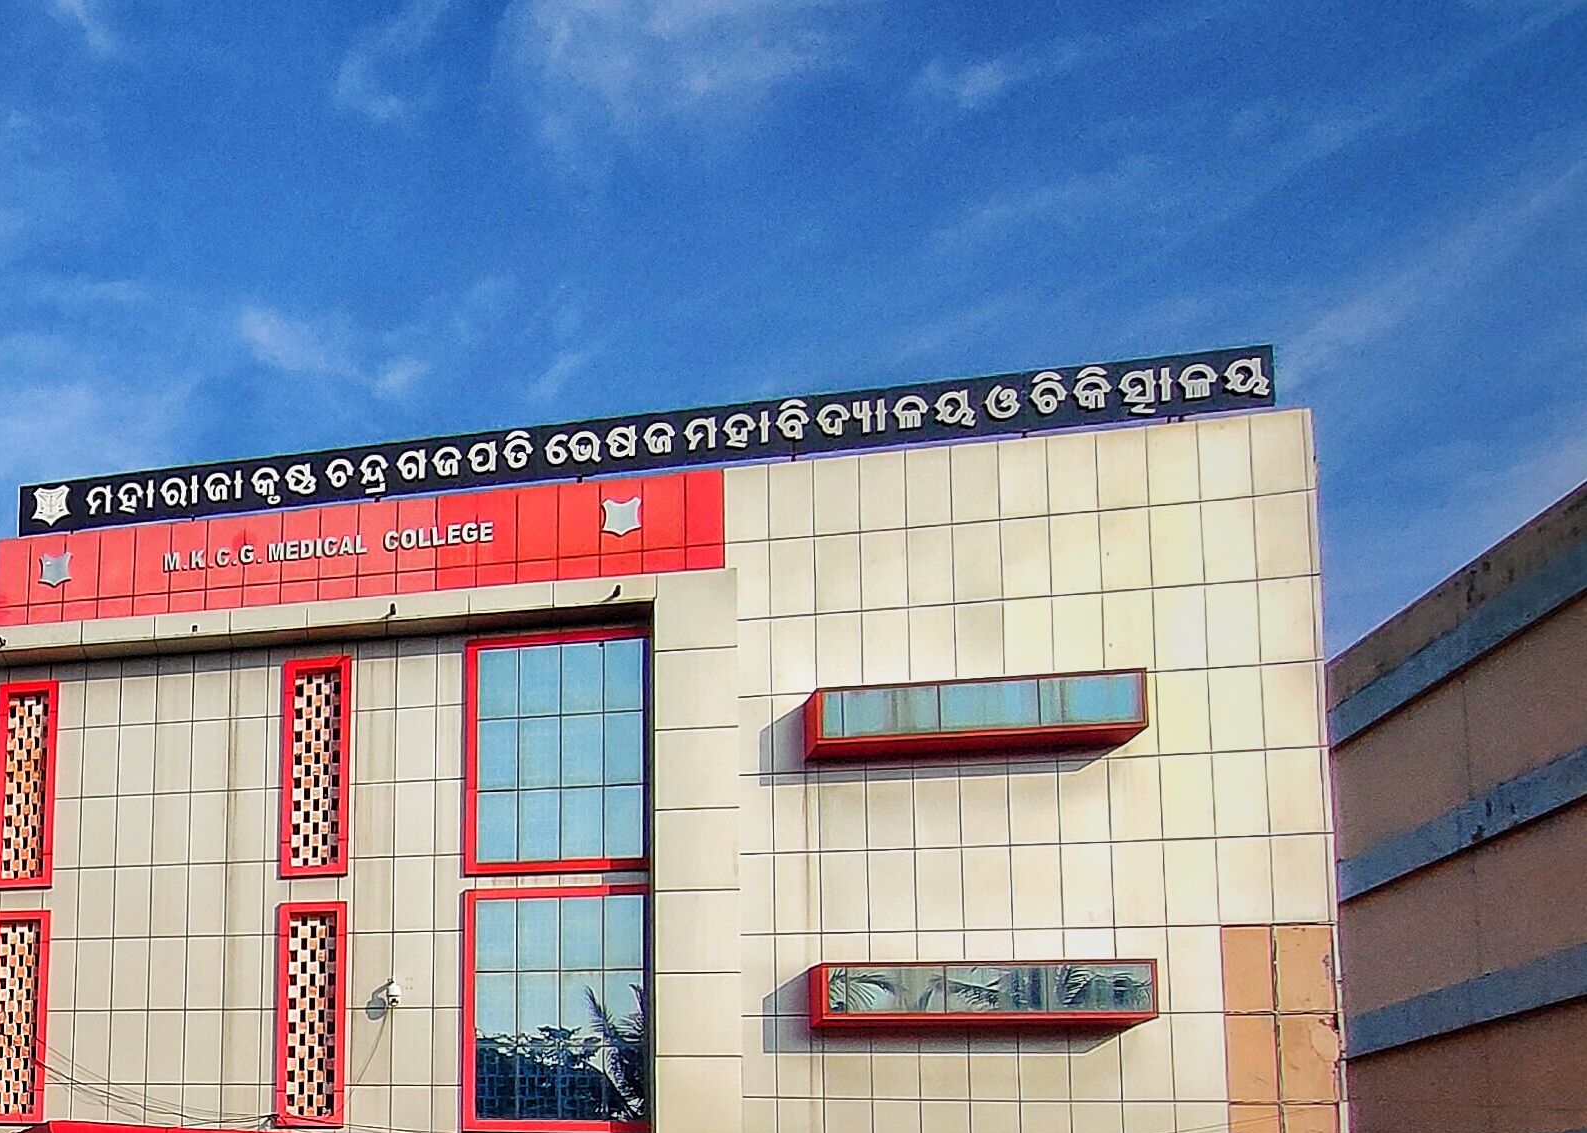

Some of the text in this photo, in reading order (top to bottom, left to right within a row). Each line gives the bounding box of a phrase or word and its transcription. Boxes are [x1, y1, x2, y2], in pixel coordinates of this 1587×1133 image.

[86, 468, 243, 515] ମହାରାଜା
[396, 430, 534, 481] ଗଜପତି
[544, 422, 676, 466] ଭେଷଜ
[163, 521, 494, 573] M.K.C.G. MEDICAL COLLEGE
